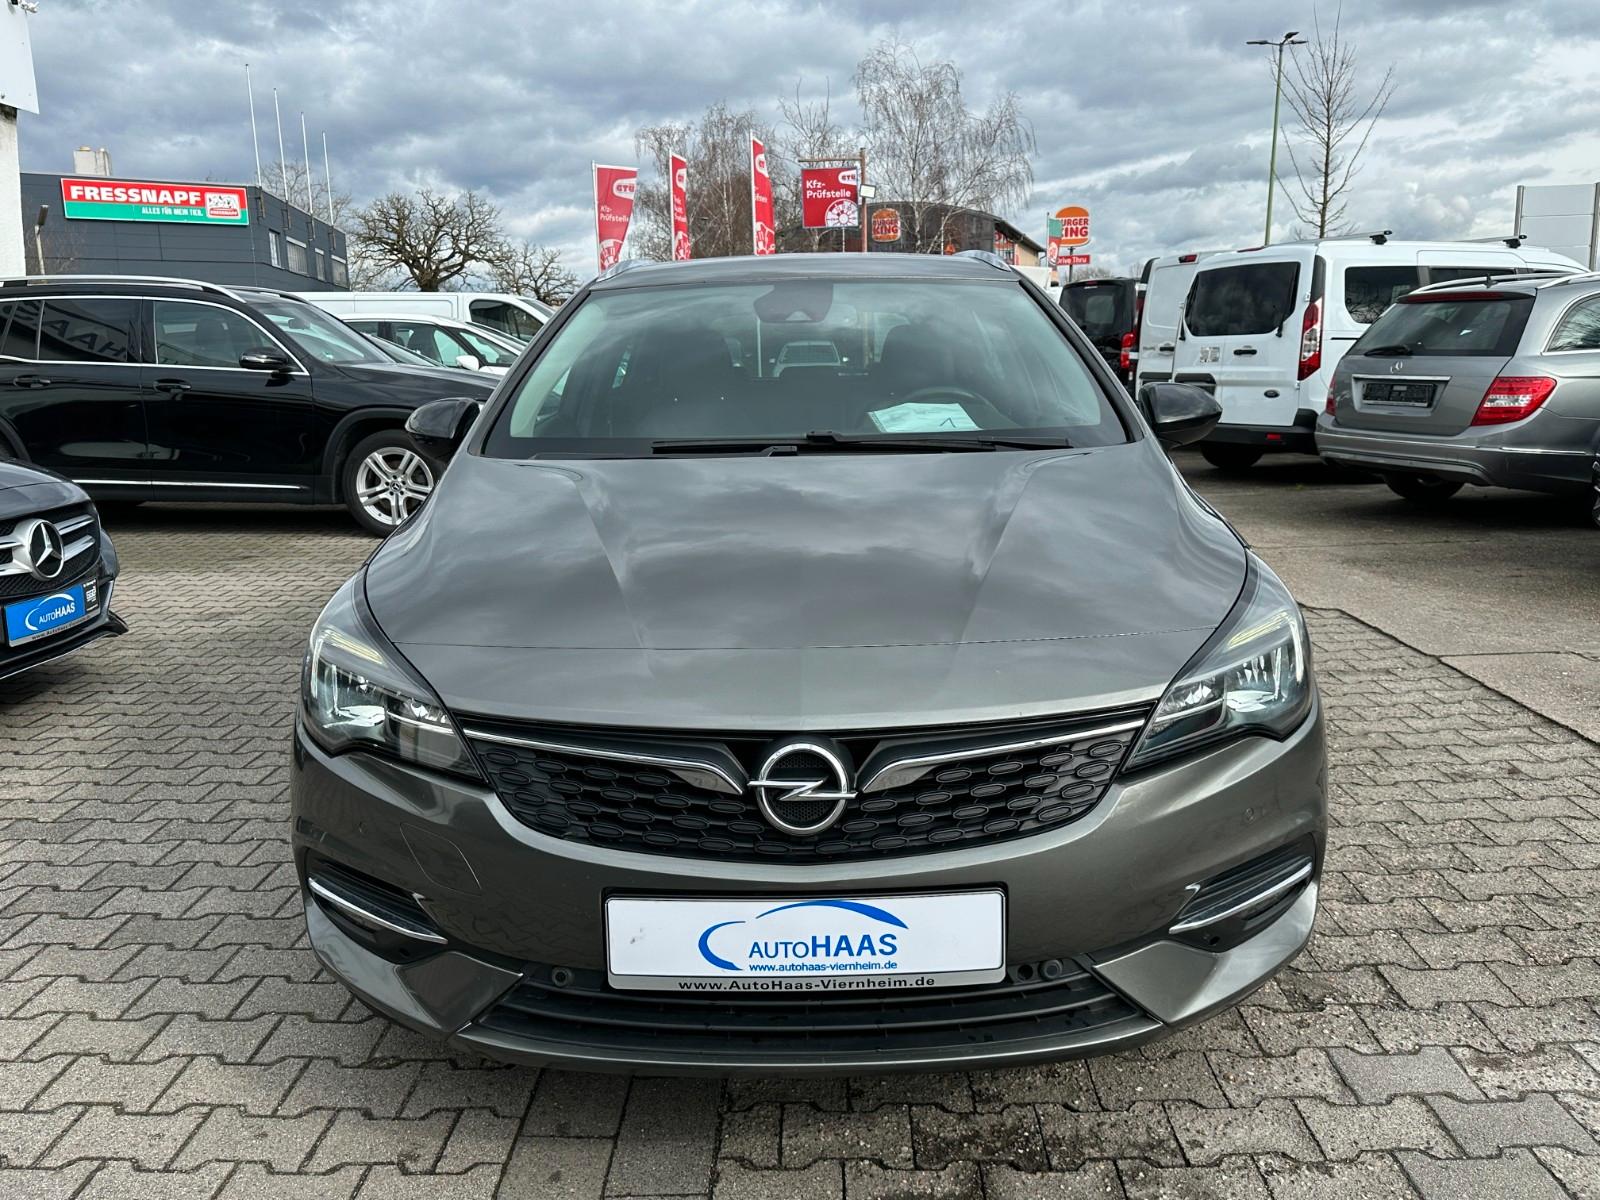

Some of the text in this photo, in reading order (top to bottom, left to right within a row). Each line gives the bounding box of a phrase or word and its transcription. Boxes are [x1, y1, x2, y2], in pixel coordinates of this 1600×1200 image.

[616, 184, 635, 192] GTÜ
[806, 180, 826, 189] Kfz-
[70, 185, 201, 205] FRESSNAPF
[806, 189, 851, 199] Prüfstelle
[141, 206, 161, 215] ALLES
[872, 218, 899, 226] BURGER
[1061, 218, 1089, 226] URGER
[872, 225, 899, 235] KING
[1061, 226, 1089, 237] ING
[748, 933, 898, 959] AUTOHAAS
[748, 960, 898, 972] www.autohaas-viernheim.de
[678, 976, 935, 991] www.AutoHaas-Viernheim.de
